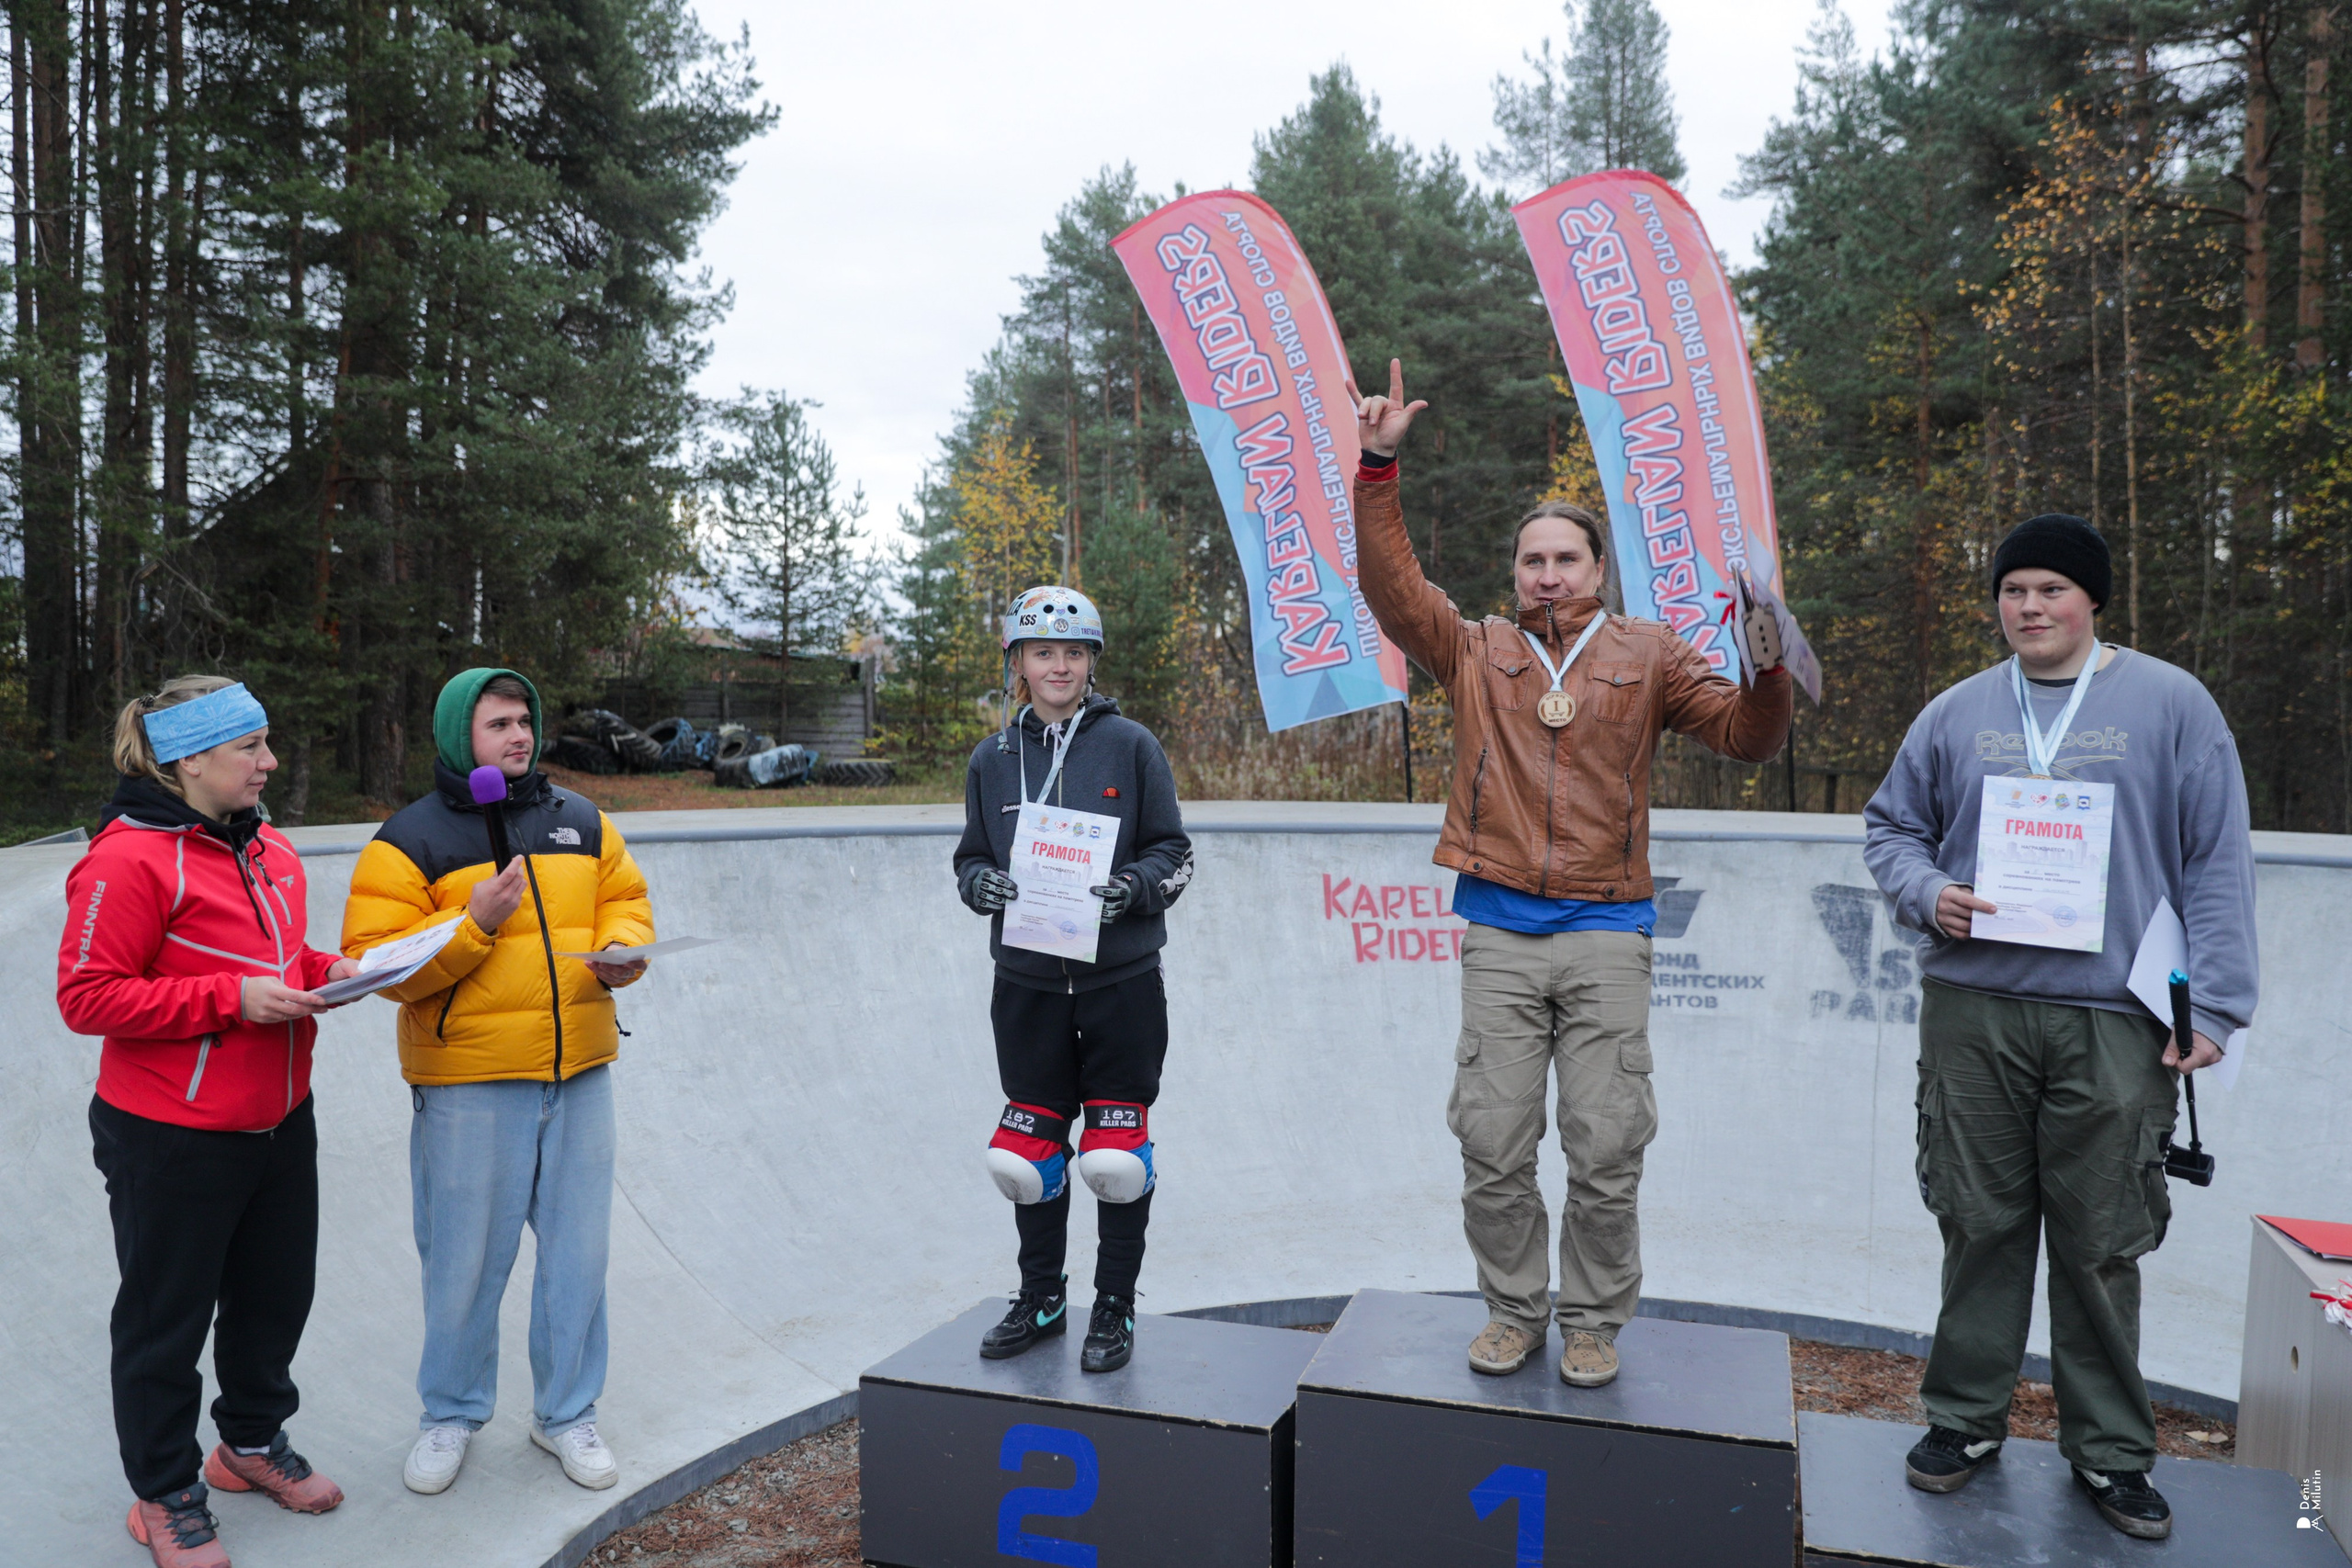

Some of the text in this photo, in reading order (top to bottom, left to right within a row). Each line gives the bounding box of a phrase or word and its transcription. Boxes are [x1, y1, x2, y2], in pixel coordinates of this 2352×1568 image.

[1020, 615, 1037, 626] KSS
[1976, 727, 2128, 755] Reok
[2005, 818, 2083, 840] ГРАМОТА
[1032, 840, 1091, 864] ГРАМОТА
[1322, 873, 1455, 920] KAREL
[1651, 952, 1700, 970] ОНД
[1651, 973, 1765, 989] ЕНТСКИХ
[1006, 1109, 1035, 1125] 187
[1102, 1110, 1136, 1120] 187
[1001, 1117, 1034, 1134] KILLER PADS
[997, 1422, 1100, 1568] 2
[1467, 1462, 1548, 1568] 1
